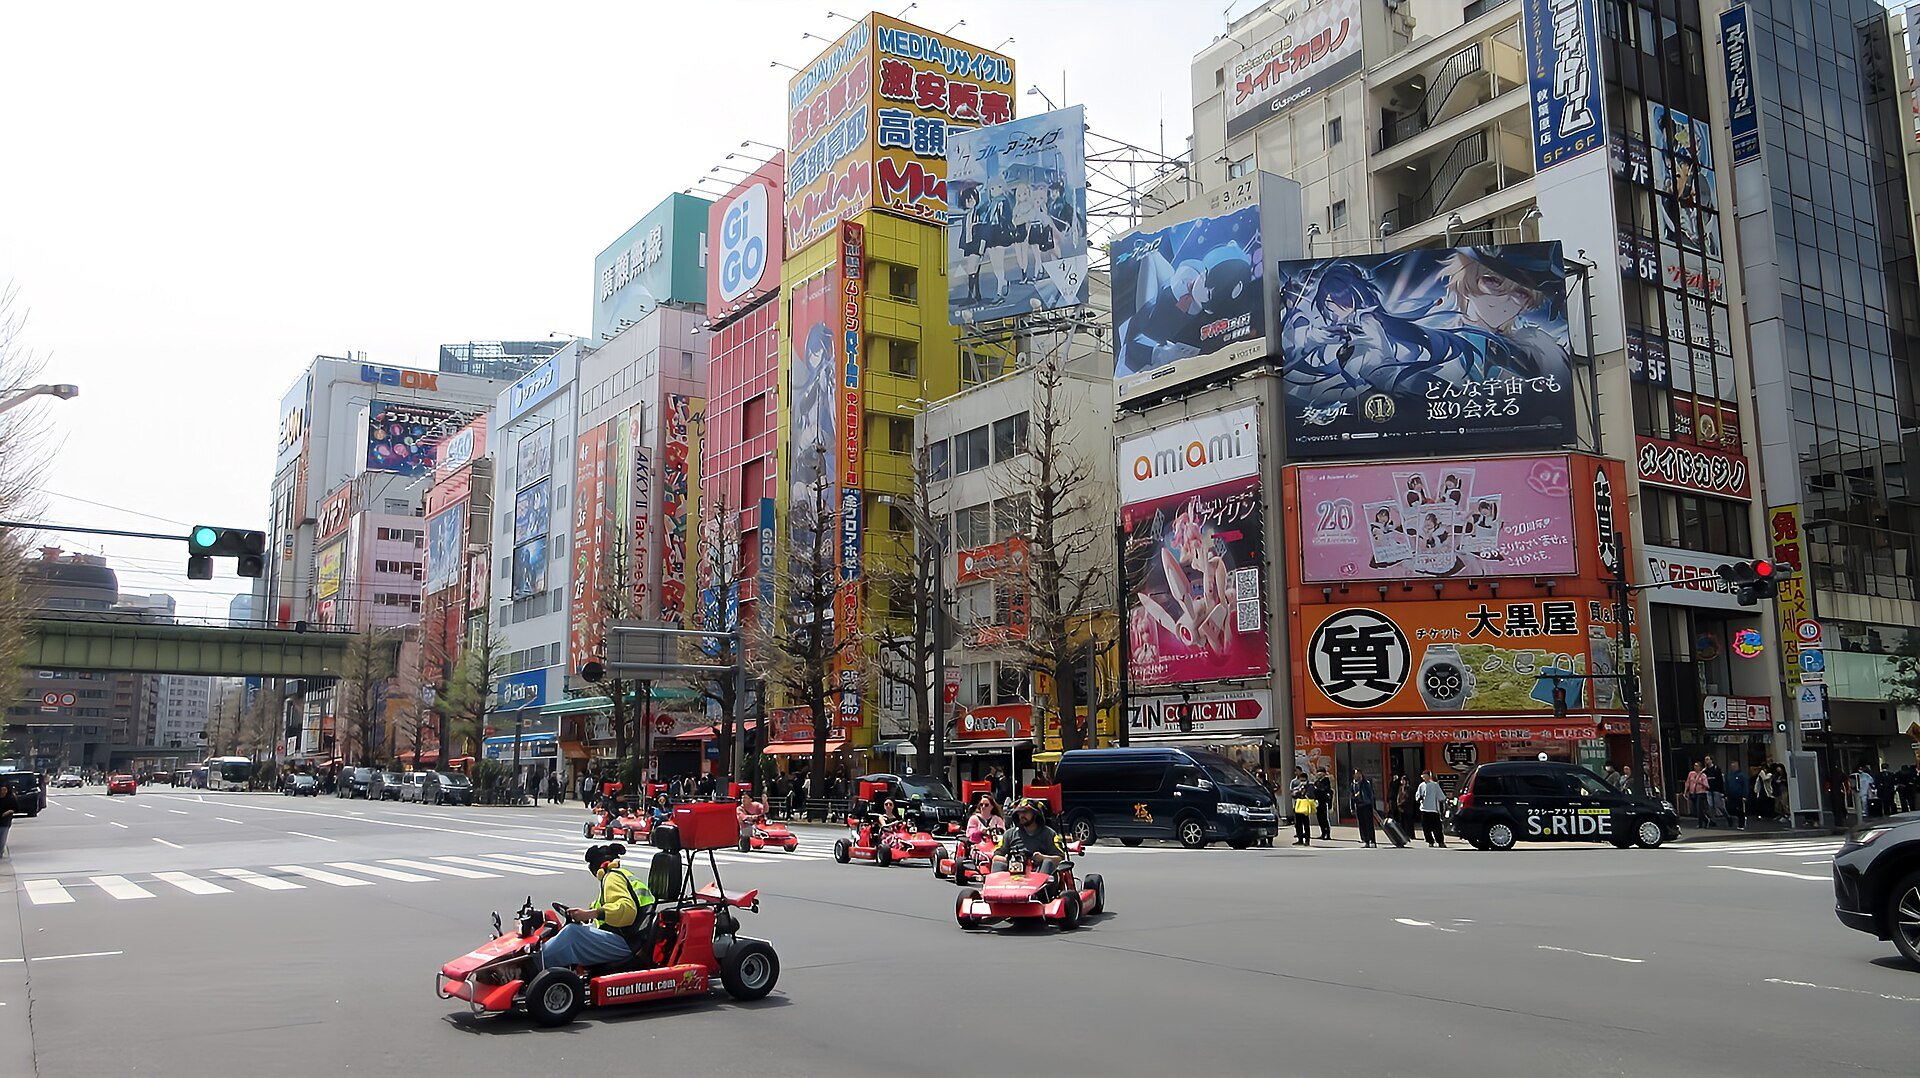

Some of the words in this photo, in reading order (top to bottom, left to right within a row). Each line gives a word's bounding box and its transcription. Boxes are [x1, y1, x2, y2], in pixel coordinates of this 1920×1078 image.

[878, 26, 1012, 84] MEDIAリサイクル
[1236, 18, 1350, 105] メイドカジノ
[880, 58, 1012, 126] 激安販売
[789, 103, 868, 199] 高額買取
[1631, 161, 1648, 184] 7F
[893, 199, 935, 219] ムーラン
[935, 210, 948, 223] AK
[1058, 262, 1078, 286] 4/8
[1640, 257, 1657, 280] 6F
[1648, 359, 1666, 381] 5F
[1425, 374, 1562, 401] どんな宇宙でも
[1426, 398, 1520, 421] 巡り会える
[1134, 429, 1243, 481] amiami
[1639, 442, 1746, 493] メイドカジノ
[634, 450, 650, 499] AKKY
[1200, 501, 1256, 530] アイリン
[633, 514, 648, 581] Tax-free
[1466, 601, 1580, 639] 大黒屋
[1416, 628, 1462, 641] チケット
[1320, 623, 1403, 697] 質
[1215, 702, 1237, 719] ZIN
[1527, 815, 1612, 835] S.RIDE
[606, 983, 634, 997] Street
